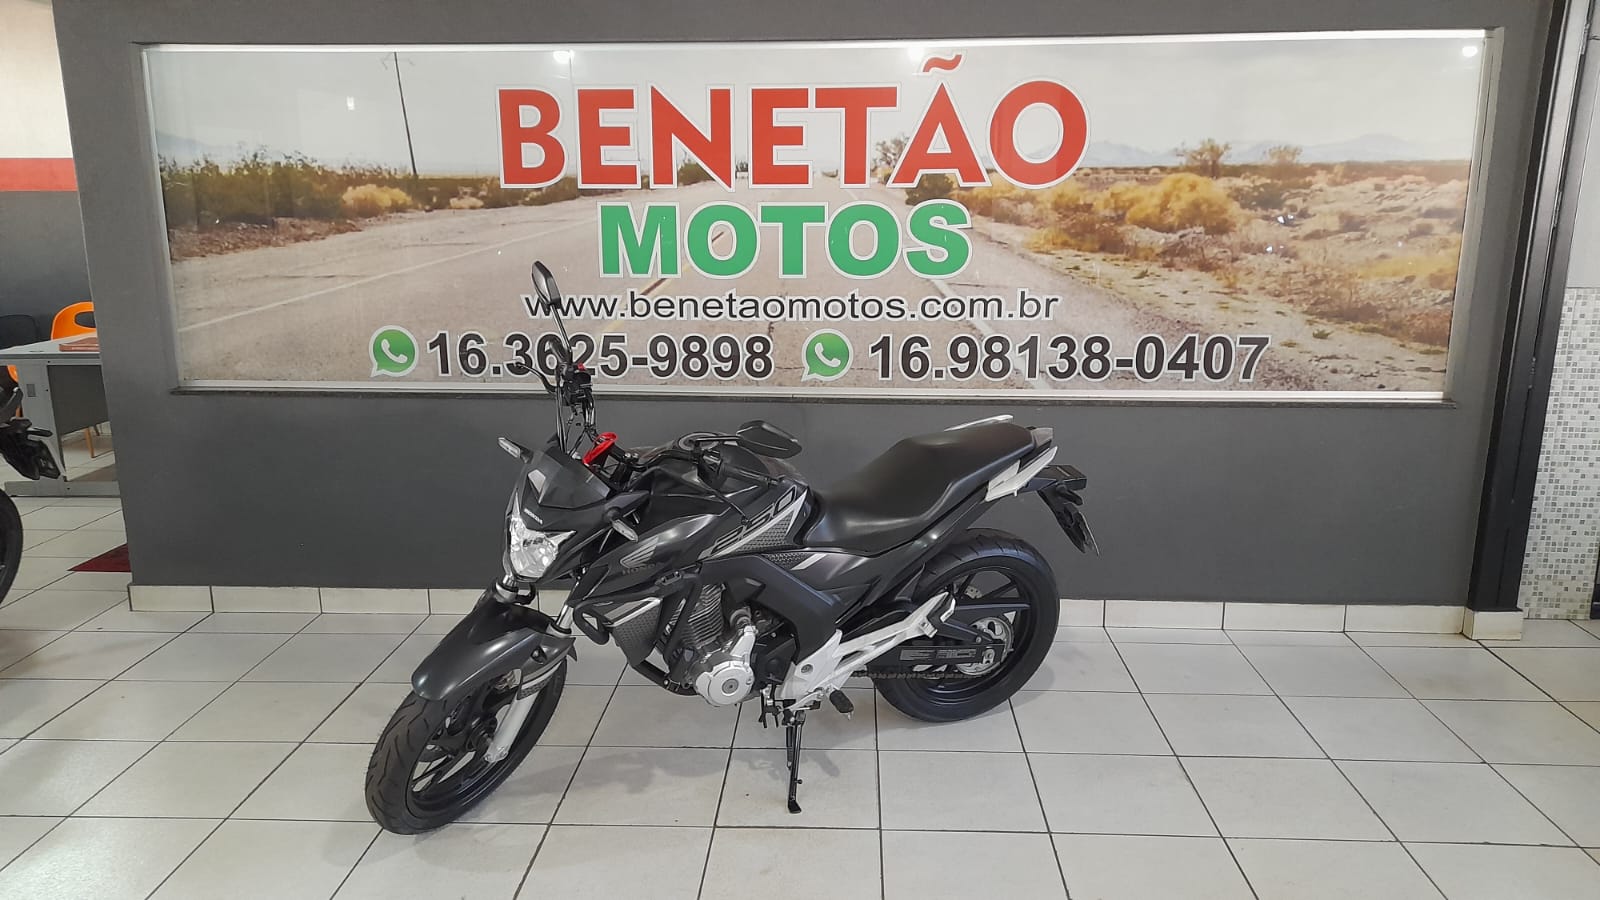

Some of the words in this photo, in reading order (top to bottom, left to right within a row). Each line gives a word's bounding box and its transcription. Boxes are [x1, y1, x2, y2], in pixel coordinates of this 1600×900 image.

[498, 53, 1089, 189] BENETÃO
[601, 203, 970, 278] MOTOS
[524, 290, 1058, 320] www.benetaomotos.com.br
[429, 332, 774, 378] 16.3625-9898
[869, 334, 1270, 382] 16.98138-0407
